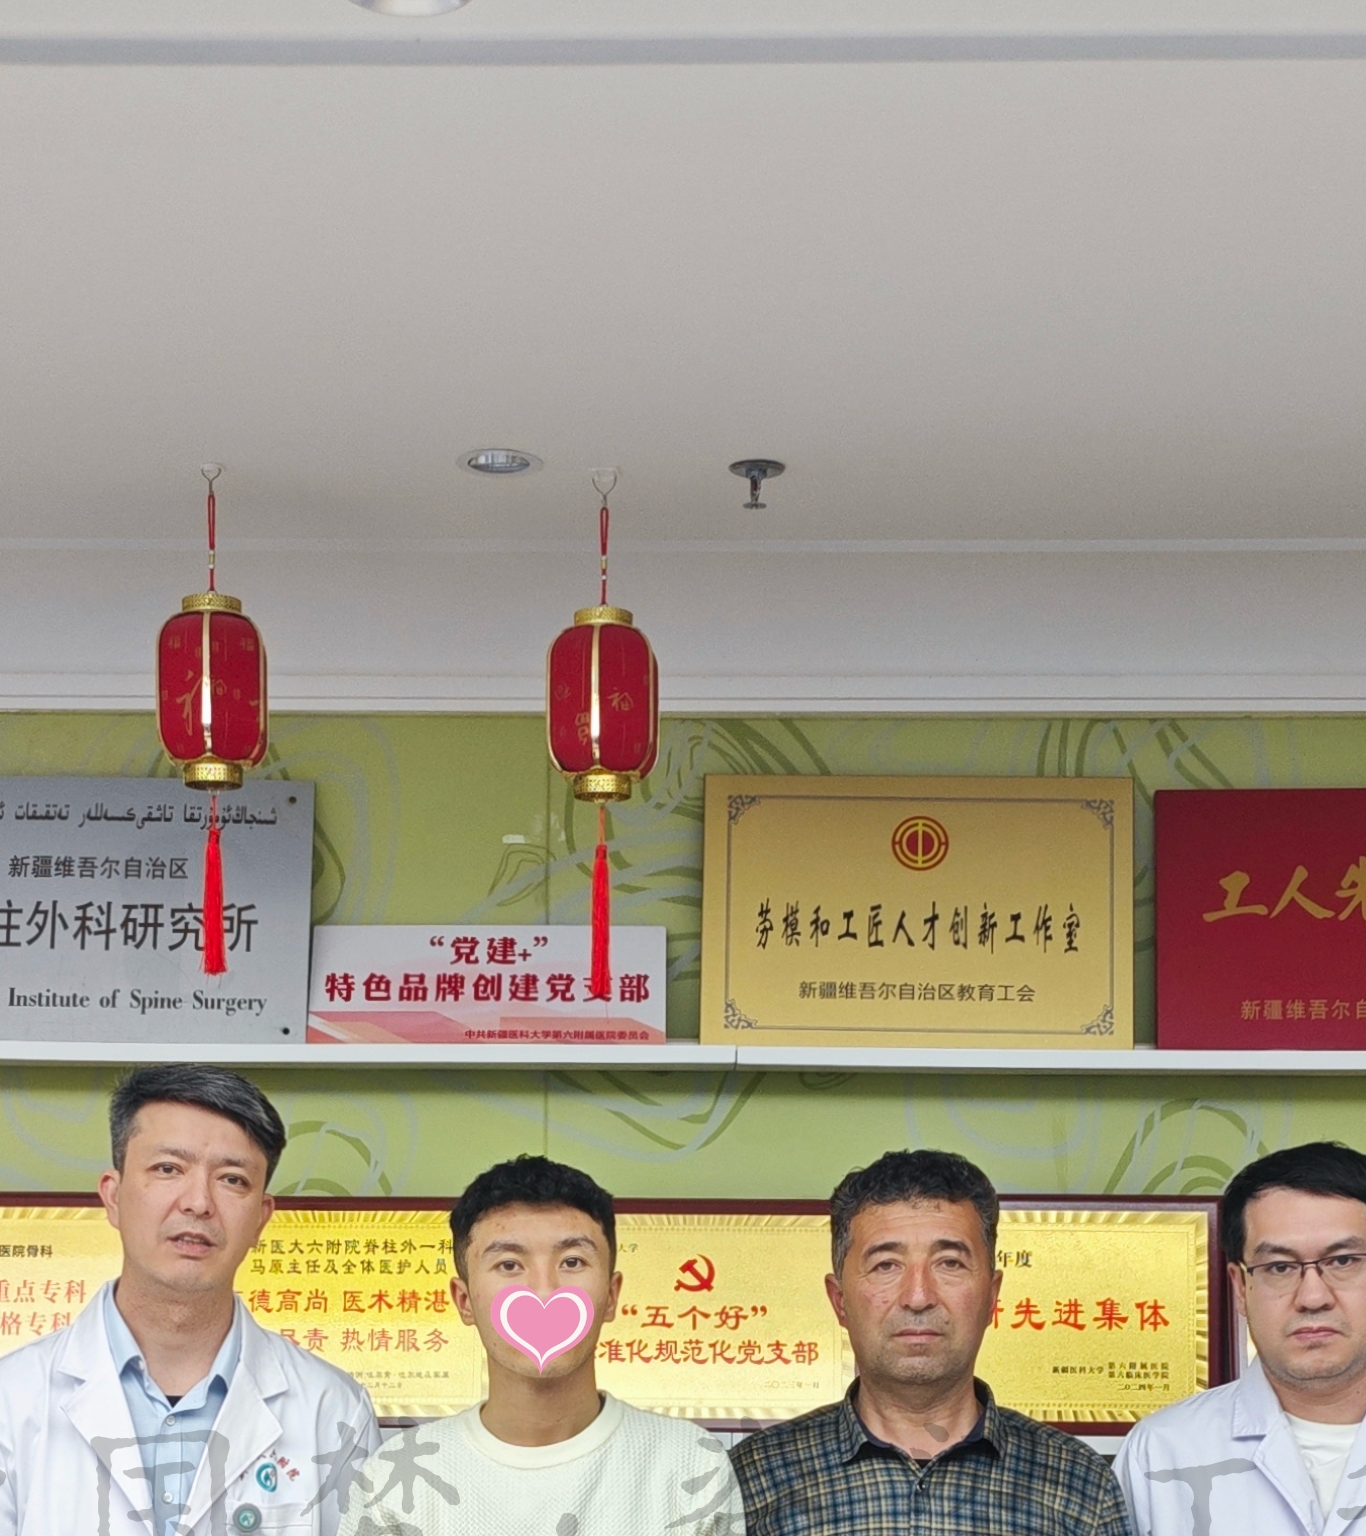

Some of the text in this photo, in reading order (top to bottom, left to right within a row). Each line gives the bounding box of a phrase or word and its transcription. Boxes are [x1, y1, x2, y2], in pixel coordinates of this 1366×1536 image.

[8, 855, 189, 879] 新疆维吾尔自治区
[755, 898, 1081, 954] 劳模和工匠人才创新工作室
[8, 987, 90, 1008] Institute
[99, 989, 119, 1009] of
[129, 989, 183, 1015] Spine
[192, 990, 268, 1016] Surgery
[798, 981, 1036, 1003] 新疆维吾尔自治区教育工会
[253, 1238, 453, 1257] 新医大六附院脊柱外一科
[250, 1258, 449, 1276] 马原主任及全体医护人员
[236, 1288, 450, 1314] 德高尚 医术精湛
[621, 1304, 768, 1330] “五个好”
[340, 1328, 450, 1352] 热情服务
[594, 1339, 820, 1366] 准化规范化党支部
